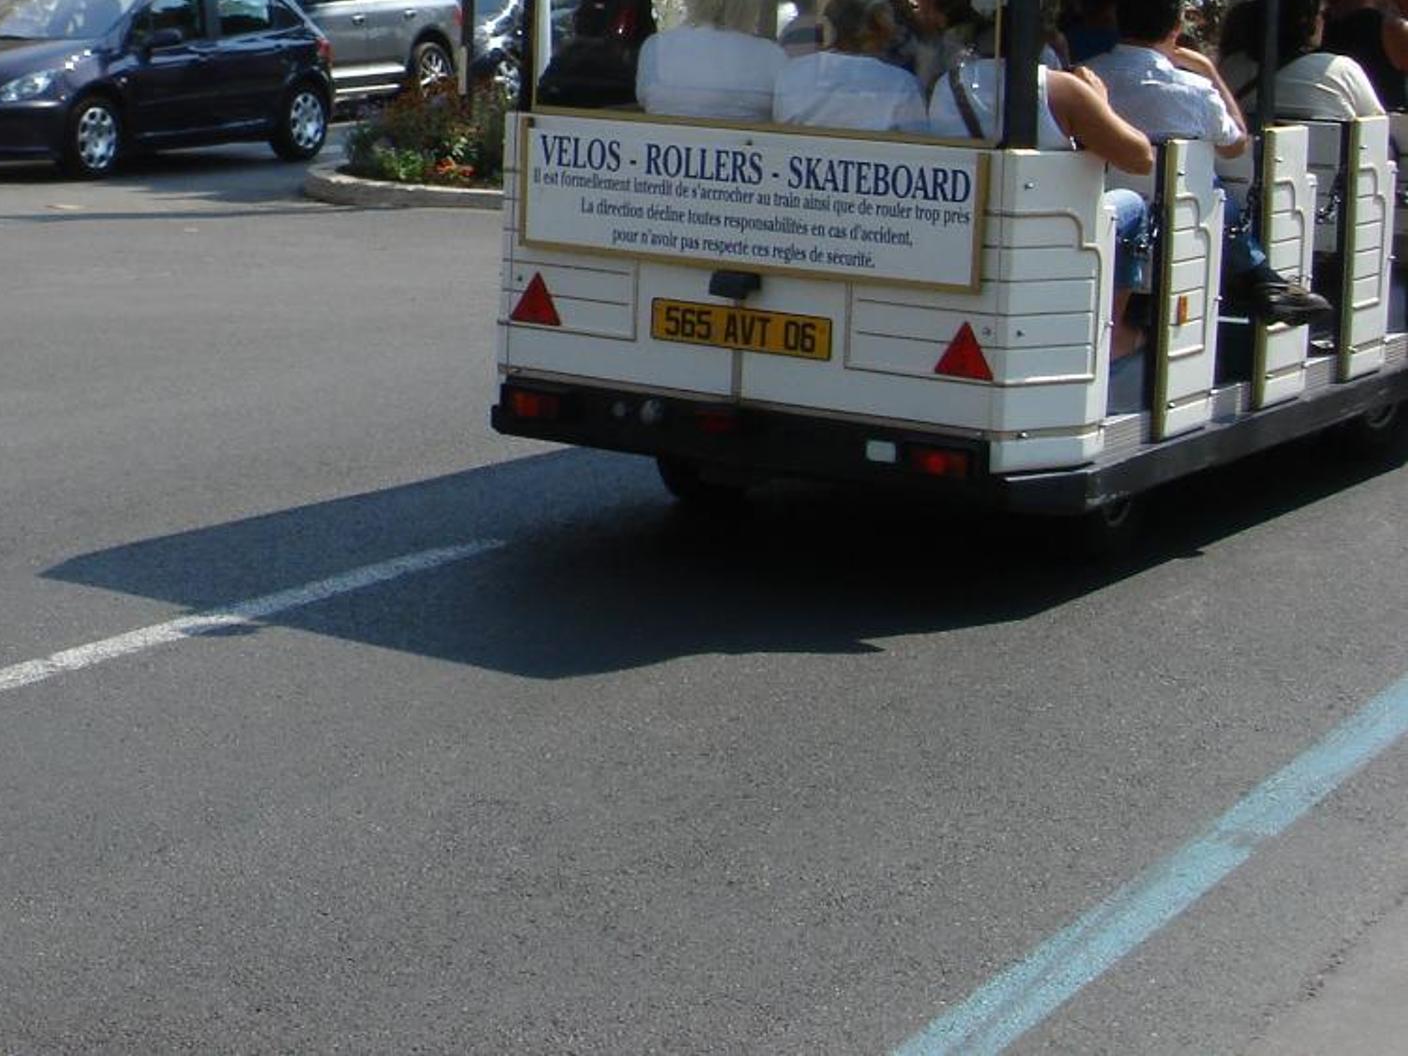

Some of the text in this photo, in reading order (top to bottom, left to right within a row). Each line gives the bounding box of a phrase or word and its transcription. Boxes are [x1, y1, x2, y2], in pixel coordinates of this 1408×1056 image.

[540, 134, 621, 172] VELOS
[645, 143, 763, 185] ROLLERS
[788, 156, 972, 202] SKATEBOARD
[533, 168, 970, 228] Il est formellement interdit de s'accrocher au train ainsi que de rouler trop près
[580, 197, 594, 214] La
[596, 198, 643, 219] direction
[646, 203, 685, 223] décline
[688, 206, 722, 226] toutes
[811, 222, 825, 236] en
[828, 224, 847, 240] cas
[849, 225, 913, 248] d'accident,
[612, 227, 638, 245] pour
[641, 227, 678, 249] n'avoir
[681, 235, 699, 253] pas
[752, 243, 770, 257] ces
[808, 246, 825, 262] de
[664, 306, 817, 353] 565 AVT 06
